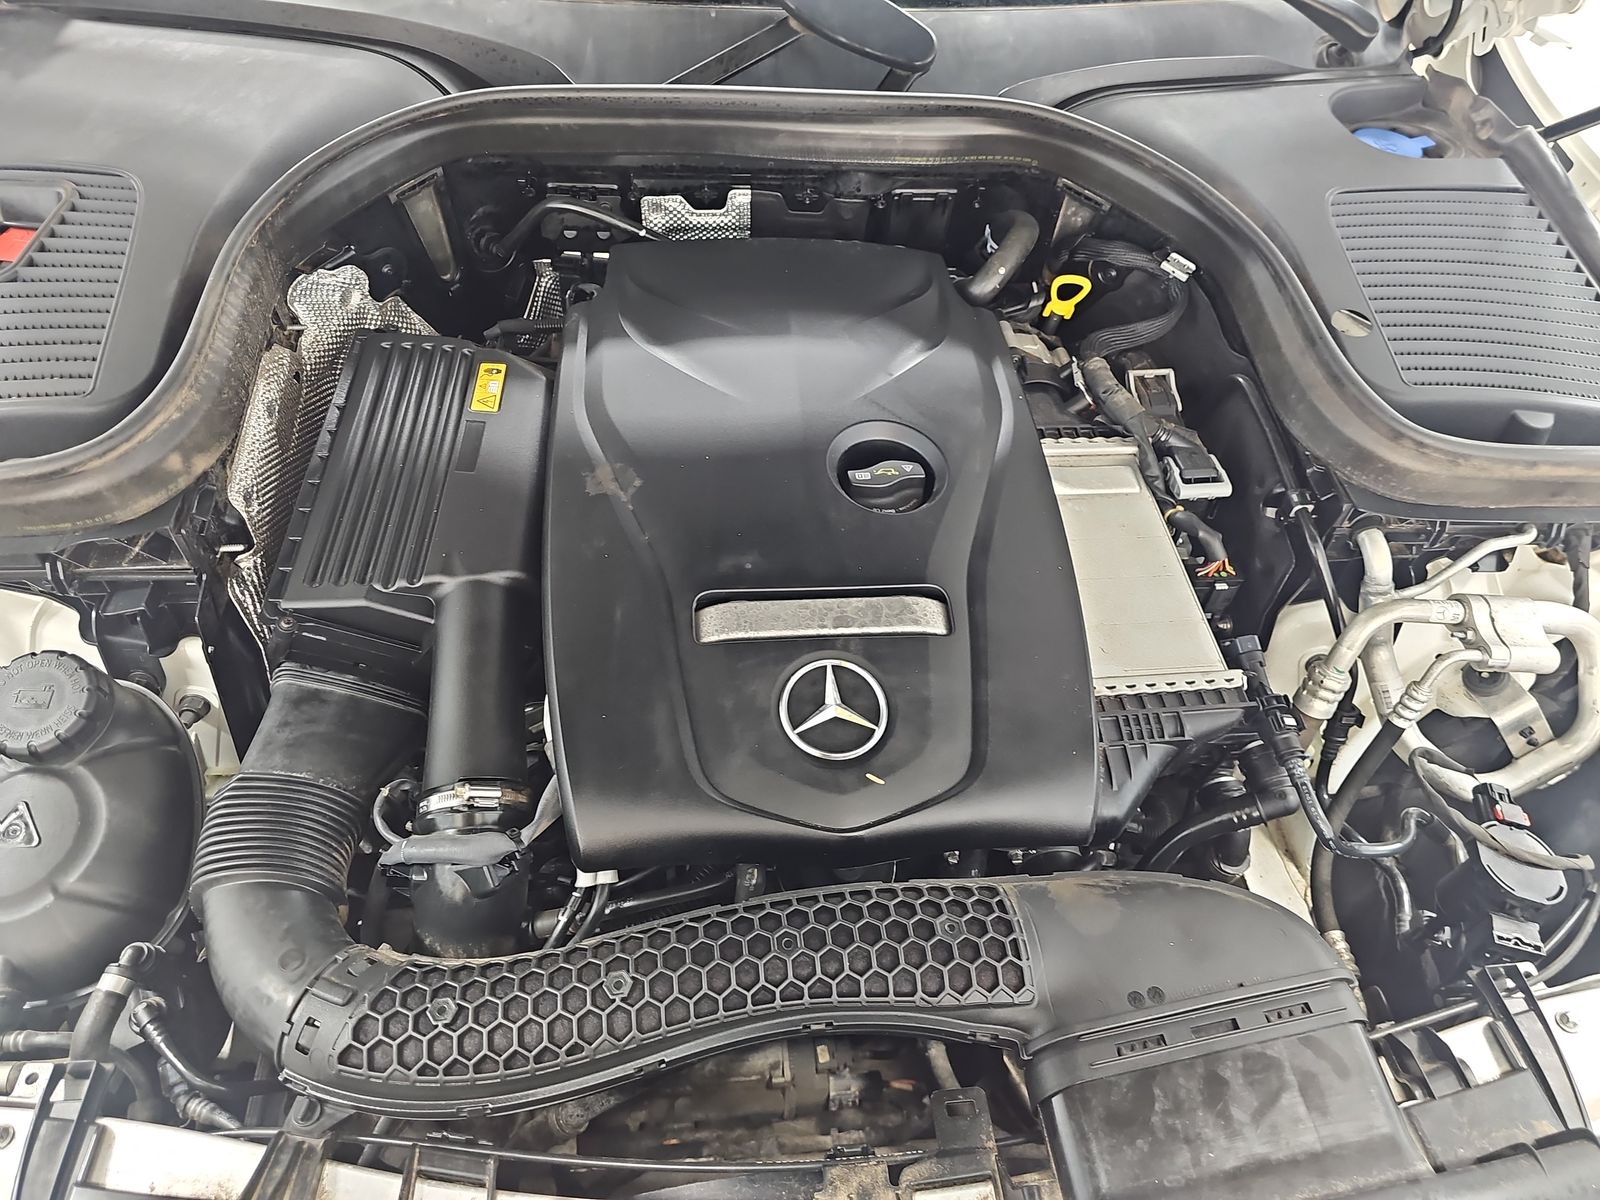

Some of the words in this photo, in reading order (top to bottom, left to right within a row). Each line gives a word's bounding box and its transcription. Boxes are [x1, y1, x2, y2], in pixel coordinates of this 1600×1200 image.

[27, 659, 52, 669] OPEN
[54, 660, 76, 679] WHEN
[27, 725, 53, 739] WENN
[54, 704, 76, 727] HEISS
